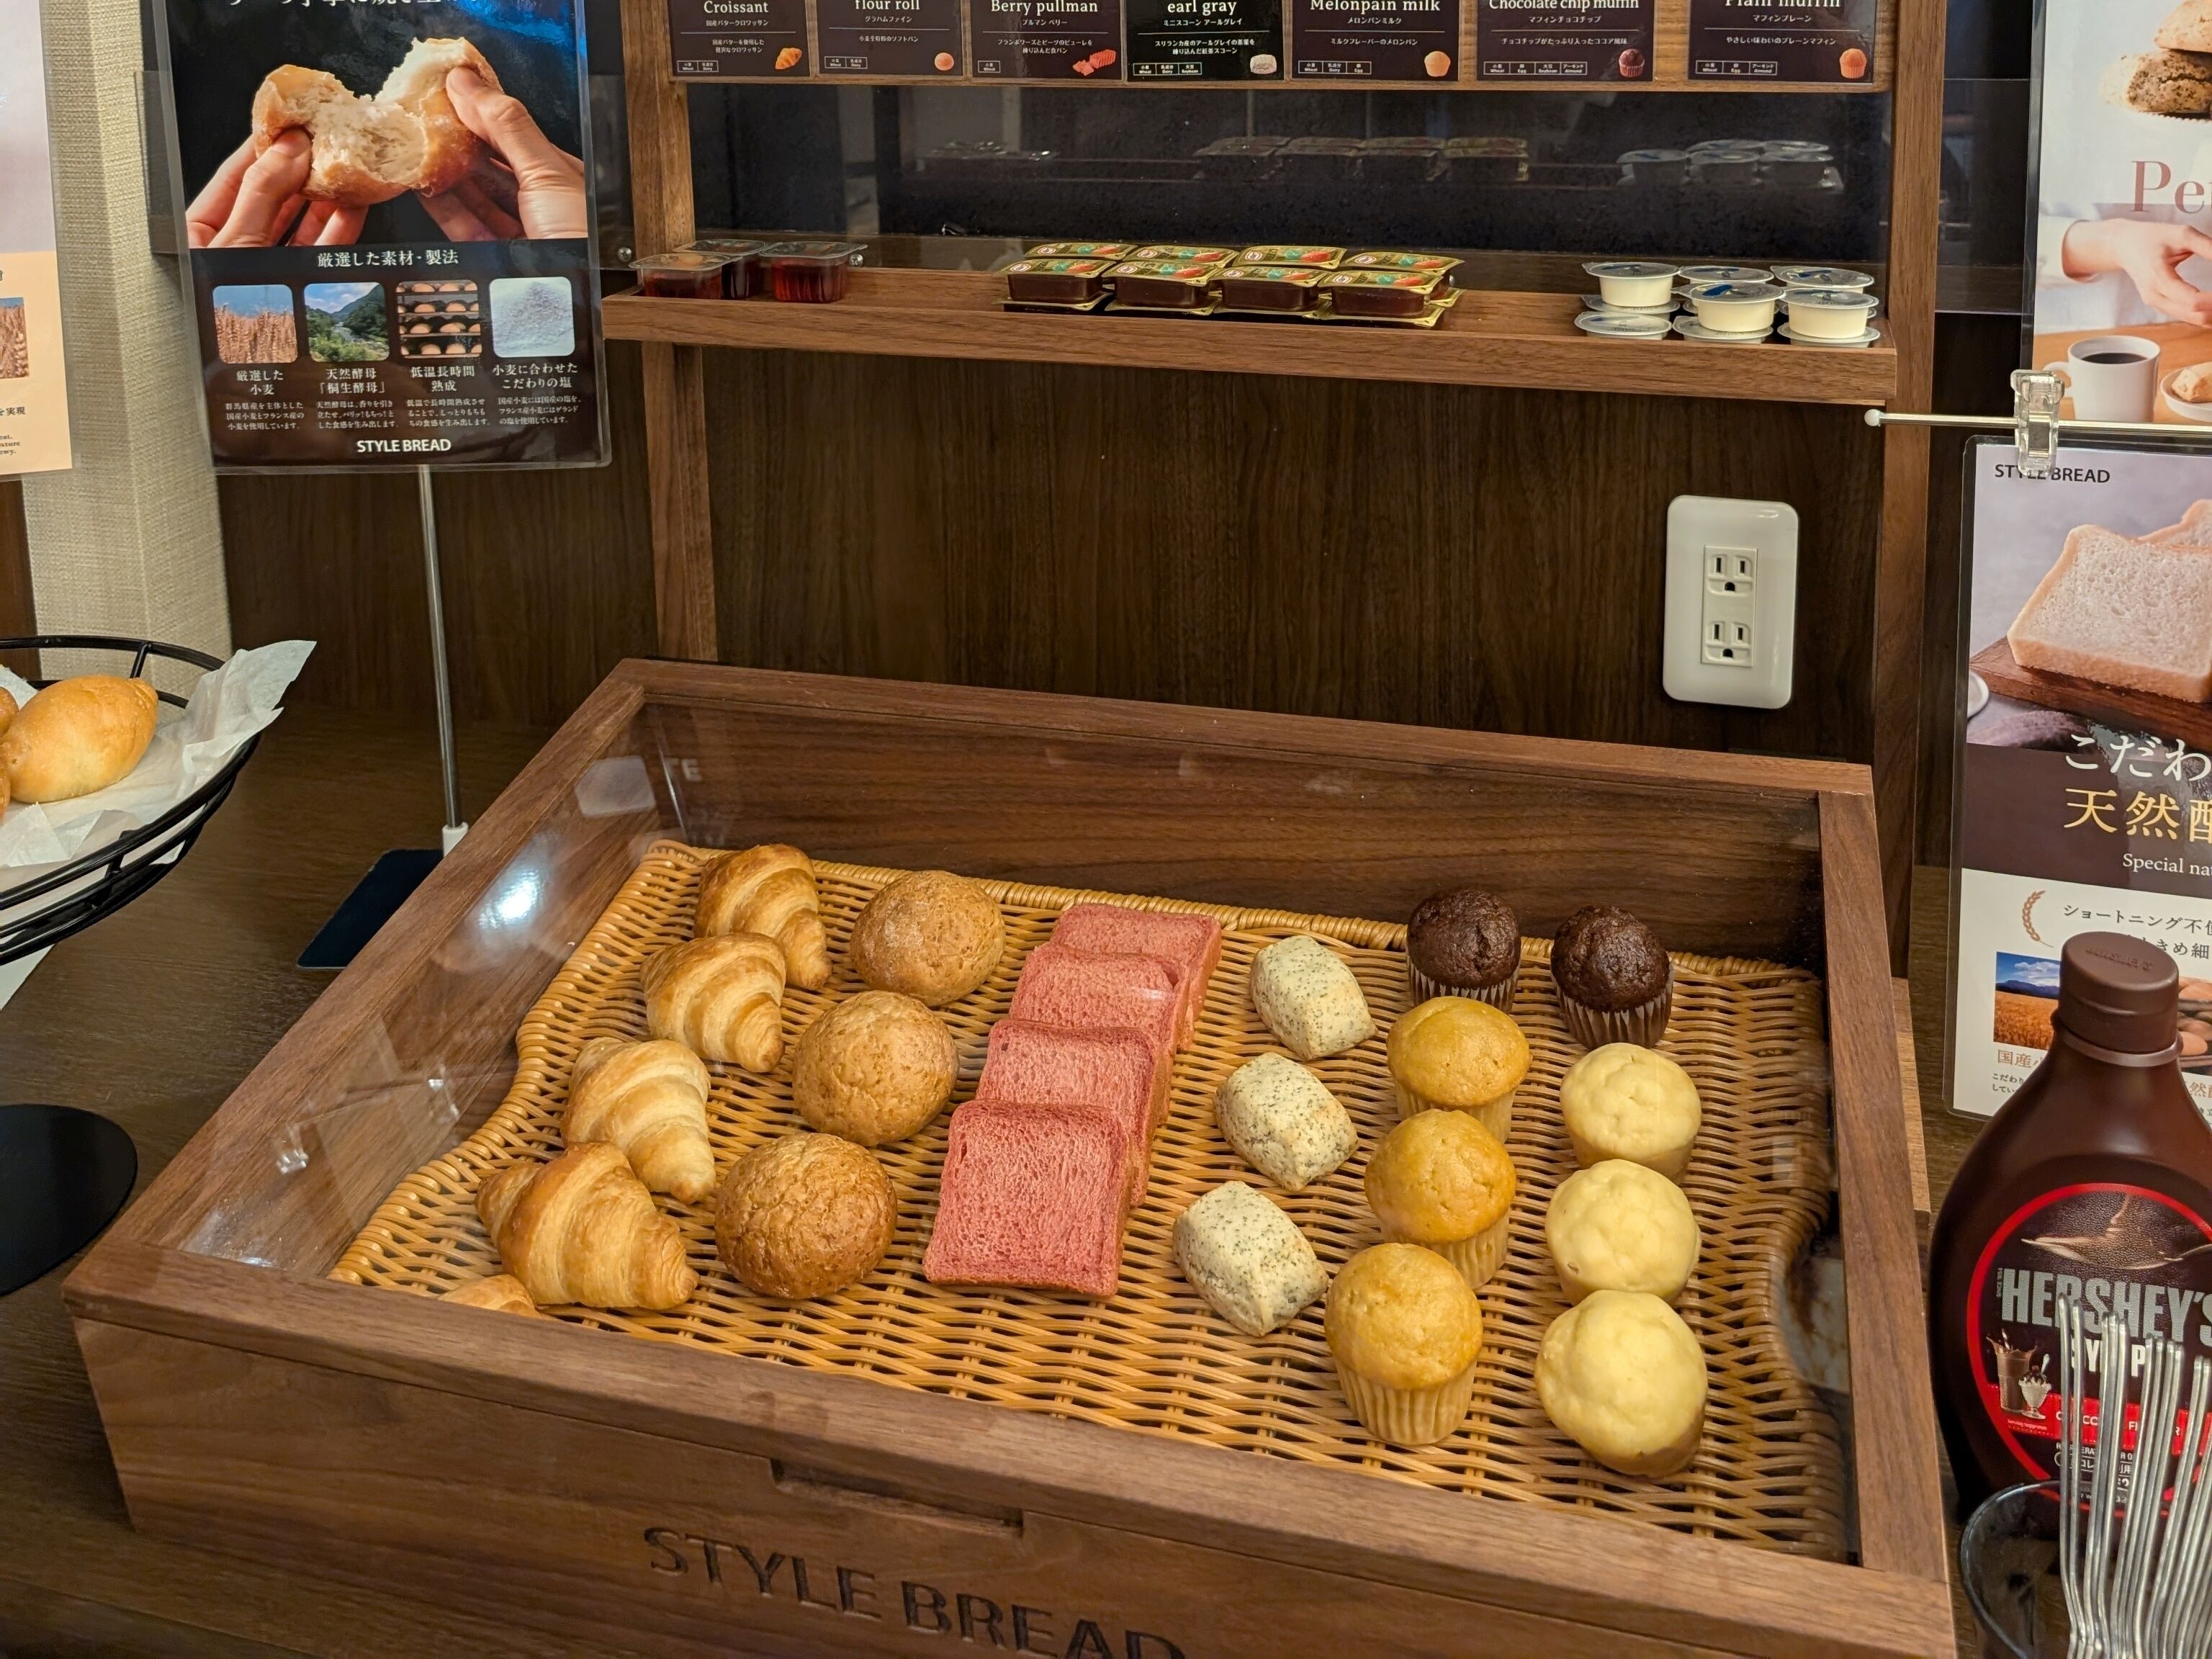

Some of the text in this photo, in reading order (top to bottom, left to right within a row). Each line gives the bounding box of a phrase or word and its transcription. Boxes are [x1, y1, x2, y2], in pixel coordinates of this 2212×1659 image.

[703, 1, 769, 13] Croissant
[855, 0, 920, 10] flour roll
[991, 0, 1098, 16] Berry pullman
[1167, 0, 1237, 16] earl gray
[1310, 0, 1441, 14] Melonpain milk
[1489, 0, 1557, 9] Chocolate
[1560, 0, 1591, 12] chip
[2131, 161, 2212, 214] Pe
[318, 249, 459, 268] 厳選した素材・製法
[236, 369, 284, 382] 厳選した
[326, 367, 377, 380] 天然酵母
[411, 365, 475, 378] 低温長時間
[493, 362, 578, 376] 小麦に合わせた
[251, 384, 275, 395] 小麦
[431, 380, 457, 392] 熟成
[503, 377, 572, 390] こだわりの塩
[357, 439, 451, 453] STYLE BREAD
[2051, 467, 2110, 483] BREAD
[2065, 734, 2212, 781] こだわ
[2123, 853, 2183, 873] Special
[2143, 938, 2209, 959] きめ細
[643, 1526, 1188, 1659] STYLE BREAD
